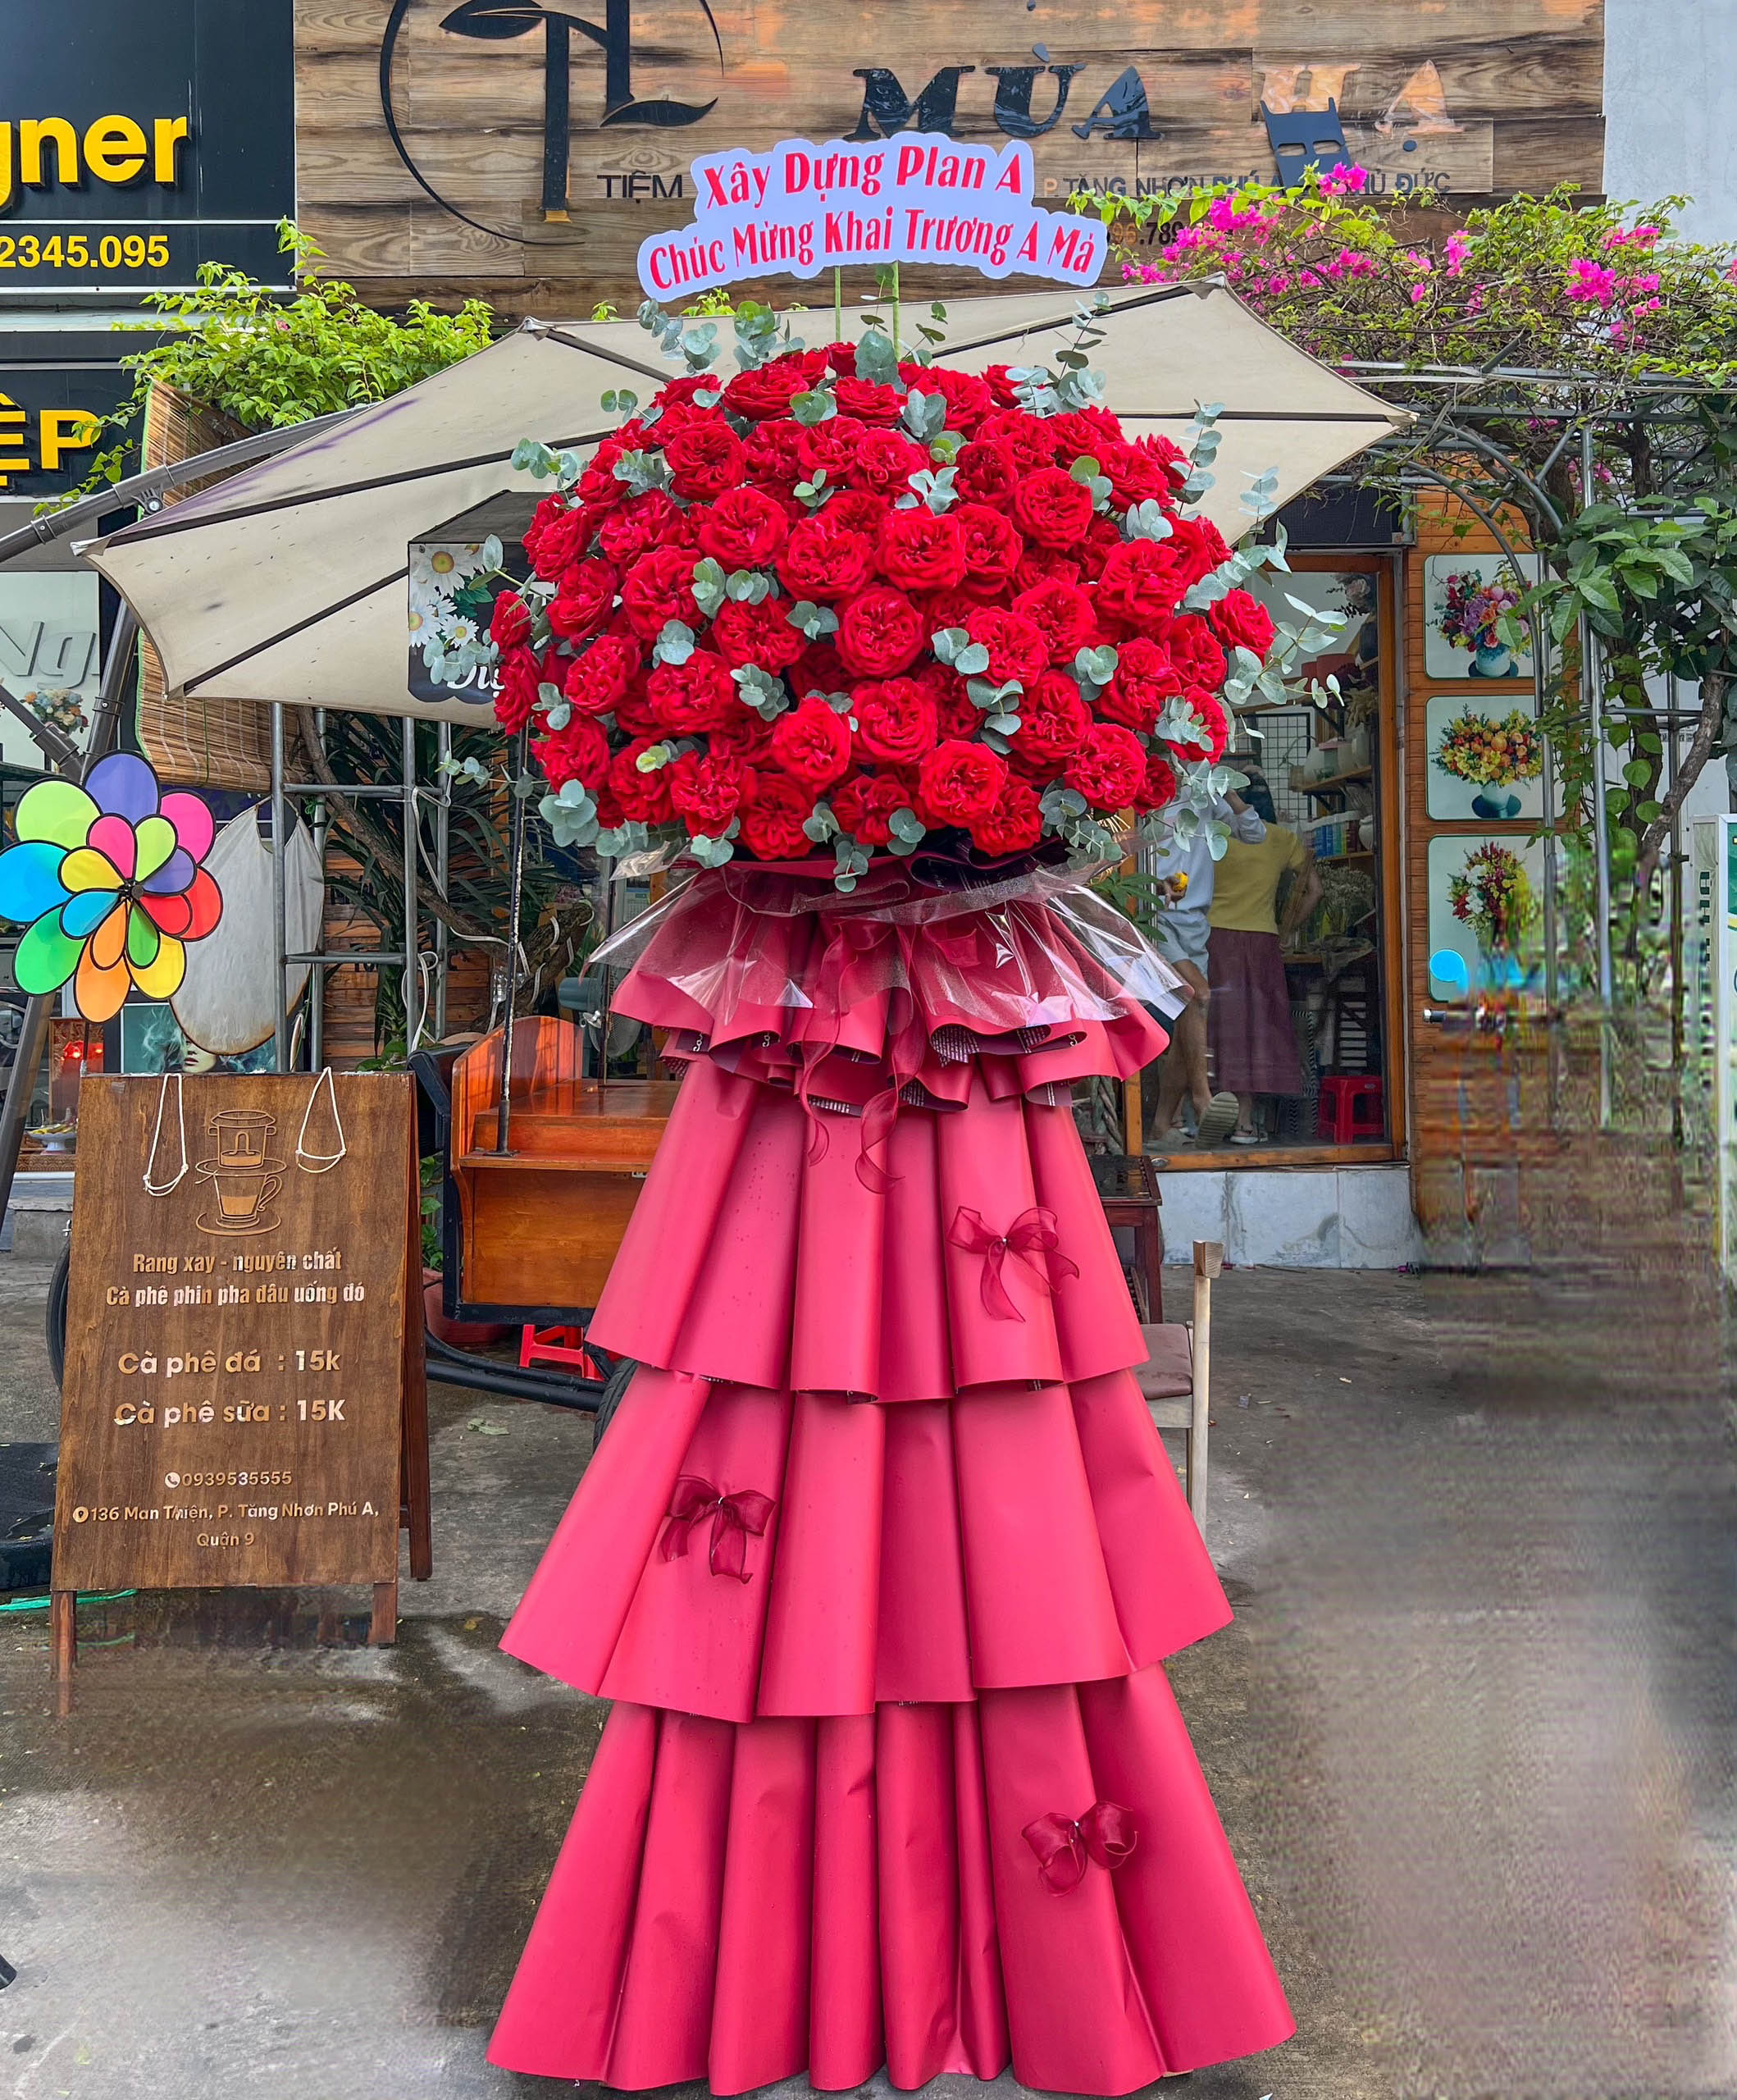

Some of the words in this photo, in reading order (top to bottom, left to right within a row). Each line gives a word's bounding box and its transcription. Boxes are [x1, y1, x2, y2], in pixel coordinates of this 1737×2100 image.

[597, 170, 683, 203] TIỆM
[704, 162, 771, 209] Xây
[785, 152, 885, 203] Dựng
[896, 145, 986, 189] Plan
[995, 153, 1022, 194] A
[1063, 173, 1126, 197] TĂNG
[1106, 220, 1183, 245] 96.789
[650, 236, 726, 290] Chúc
[732, 221, 814, 267] Mừng
[825, 206, 894, 253] Khai
[905, 208, 1014, 266] Trương
[1016, 221, 1038, 262] A
[133, 1253, 178, 1275] Rang
[183, 1255, 216, 1274] xay
[232, 1251, 296, 1273] nguyên
[302, 1246, 342, 1271] chất
[106, 1285, 130, 1306] Cà
[135, 1285, 168, 1308] phê
[173, 1285, 212, 1307] phin
[217, 1285, 250, 1306] pha
[256, 1283, 288, 1303] đâu
[294, 1281, 338, 1304] uống
[343, 1281, 366, 1302] đó
[118, 1350, 158, 1375] Cà
[166, 1350, 217, 1378] phê
[225, 1349, 262, 1372] đá
[295, 1349, 341, 1372] 15k
[114, 1400, 156, 1426] Cà
[164, 1399, 215, 1428] phê
[223, 1399, 270, 1423] sữa
[297, 1399, 346, 1422] 15K
[181, 1471, 293, 1487] 0939535555
[91, 1506, 120, 1522] 136
[124, 1506, 159, 1521] Man
[217, 1504, 233, 1518] P.
[238, 1503, 279, 1519] Tăng
[281, 1502, 323, 1518] Nhơn
[327, 1501, 358, 1517] Phú
[361, 1501, 379, 1517] A,
[196, 1532, 239, 1550] Quận
[244, 1532, 256, 1547] 9
